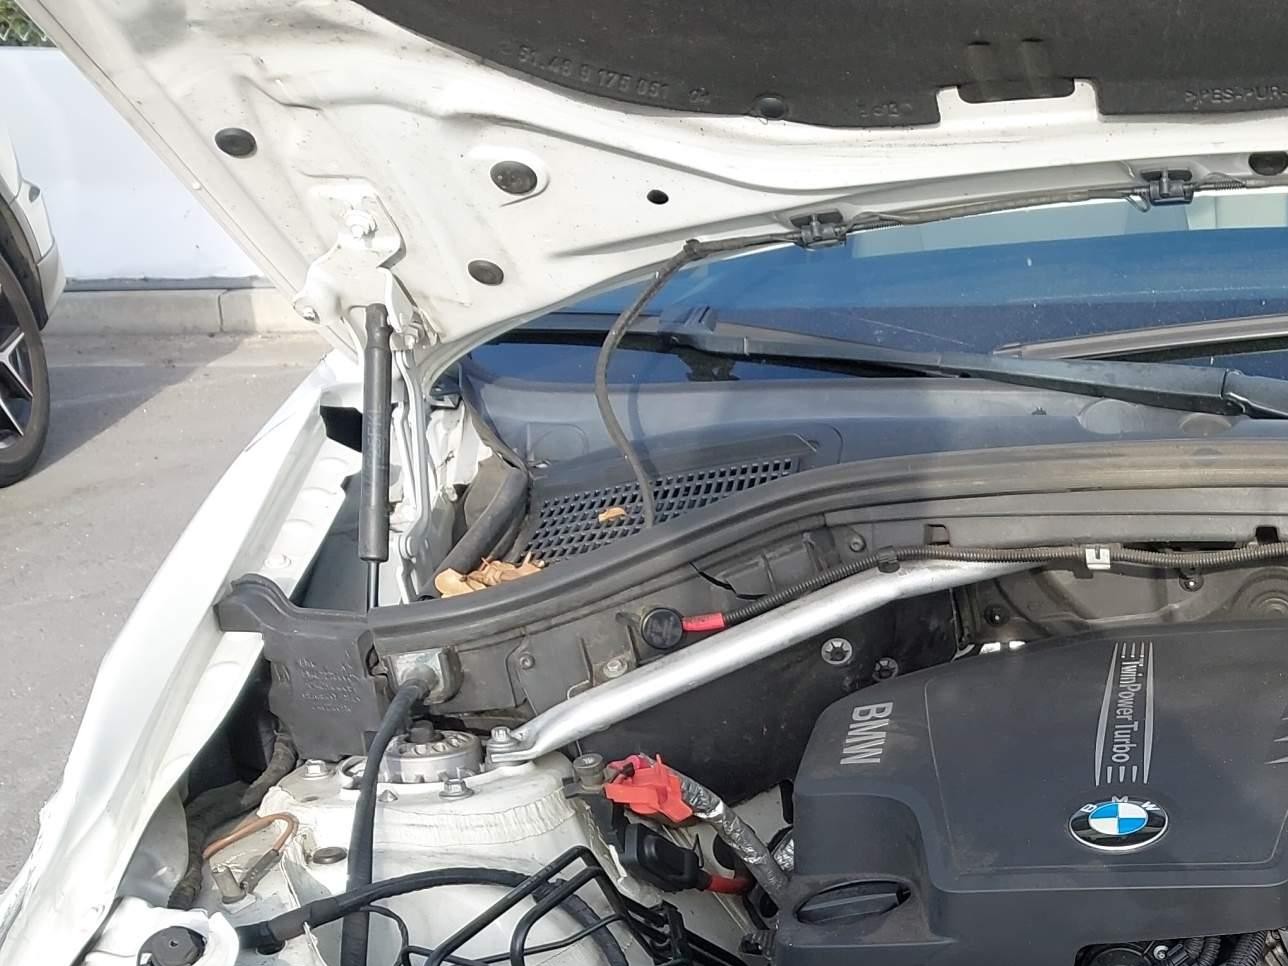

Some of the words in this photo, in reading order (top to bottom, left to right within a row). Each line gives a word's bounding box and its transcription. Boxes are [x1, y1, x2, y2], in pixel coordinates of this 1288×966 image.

[1116, 658, 1144, 721] TwinPower
[840, 702, 893, 764] BMW
[1112, 721, 1138, 763] Turbo
[1080, 795, 1160, 813] BMW
